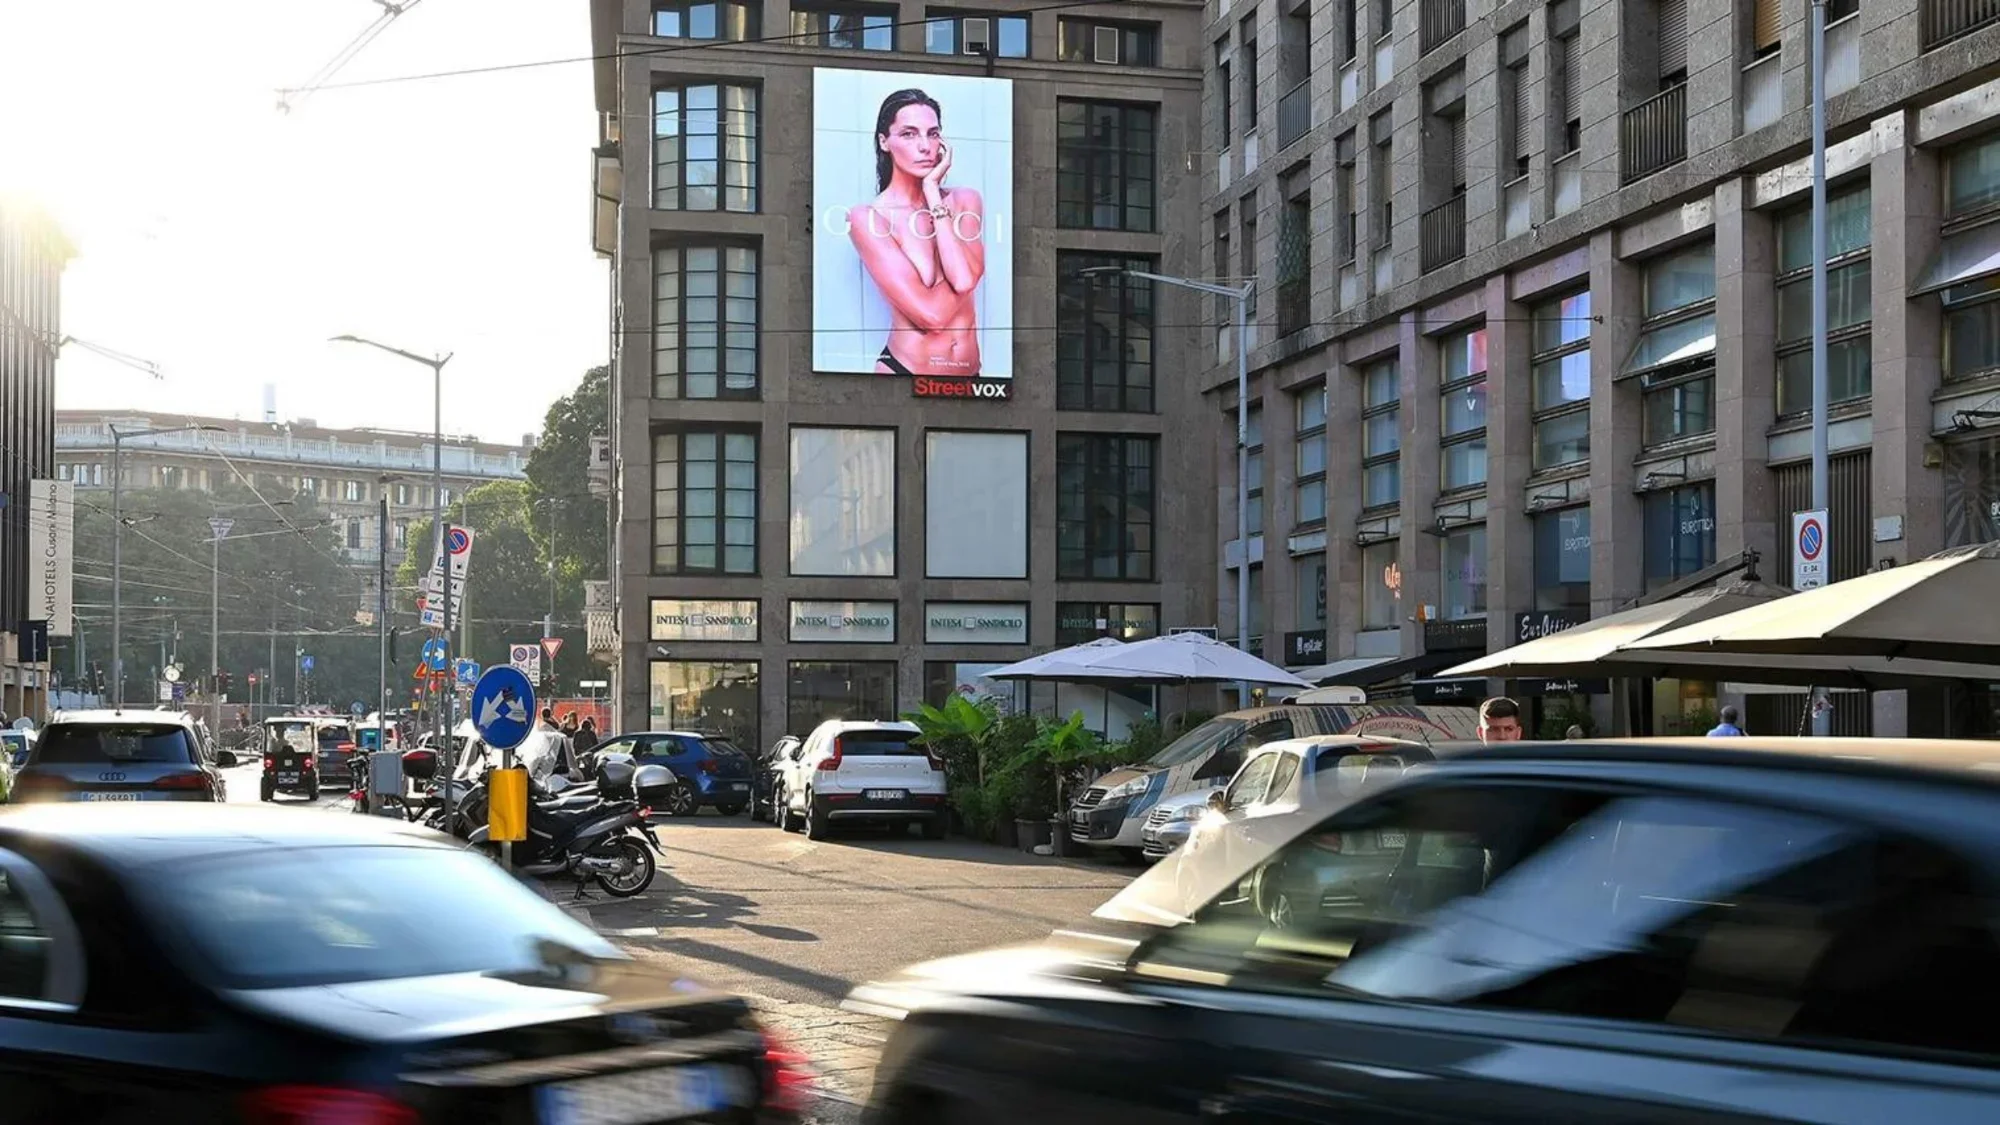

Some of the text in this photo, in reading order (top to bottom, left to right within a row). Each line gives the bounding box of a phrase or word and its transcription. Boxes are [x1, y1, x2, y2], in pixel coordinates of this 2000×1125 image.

[823, 204, 1003, 243] GUCCI
[914, 377, 1006, 398] Streetvox
[45, 484, 57, 631] UNAHOTELS Cusani Milano
[656, 615, 753, 626] INTESA SANPAOLO
[796, 616, 828, 627] INTESA
[931, 618, 962, 629] INTESA
